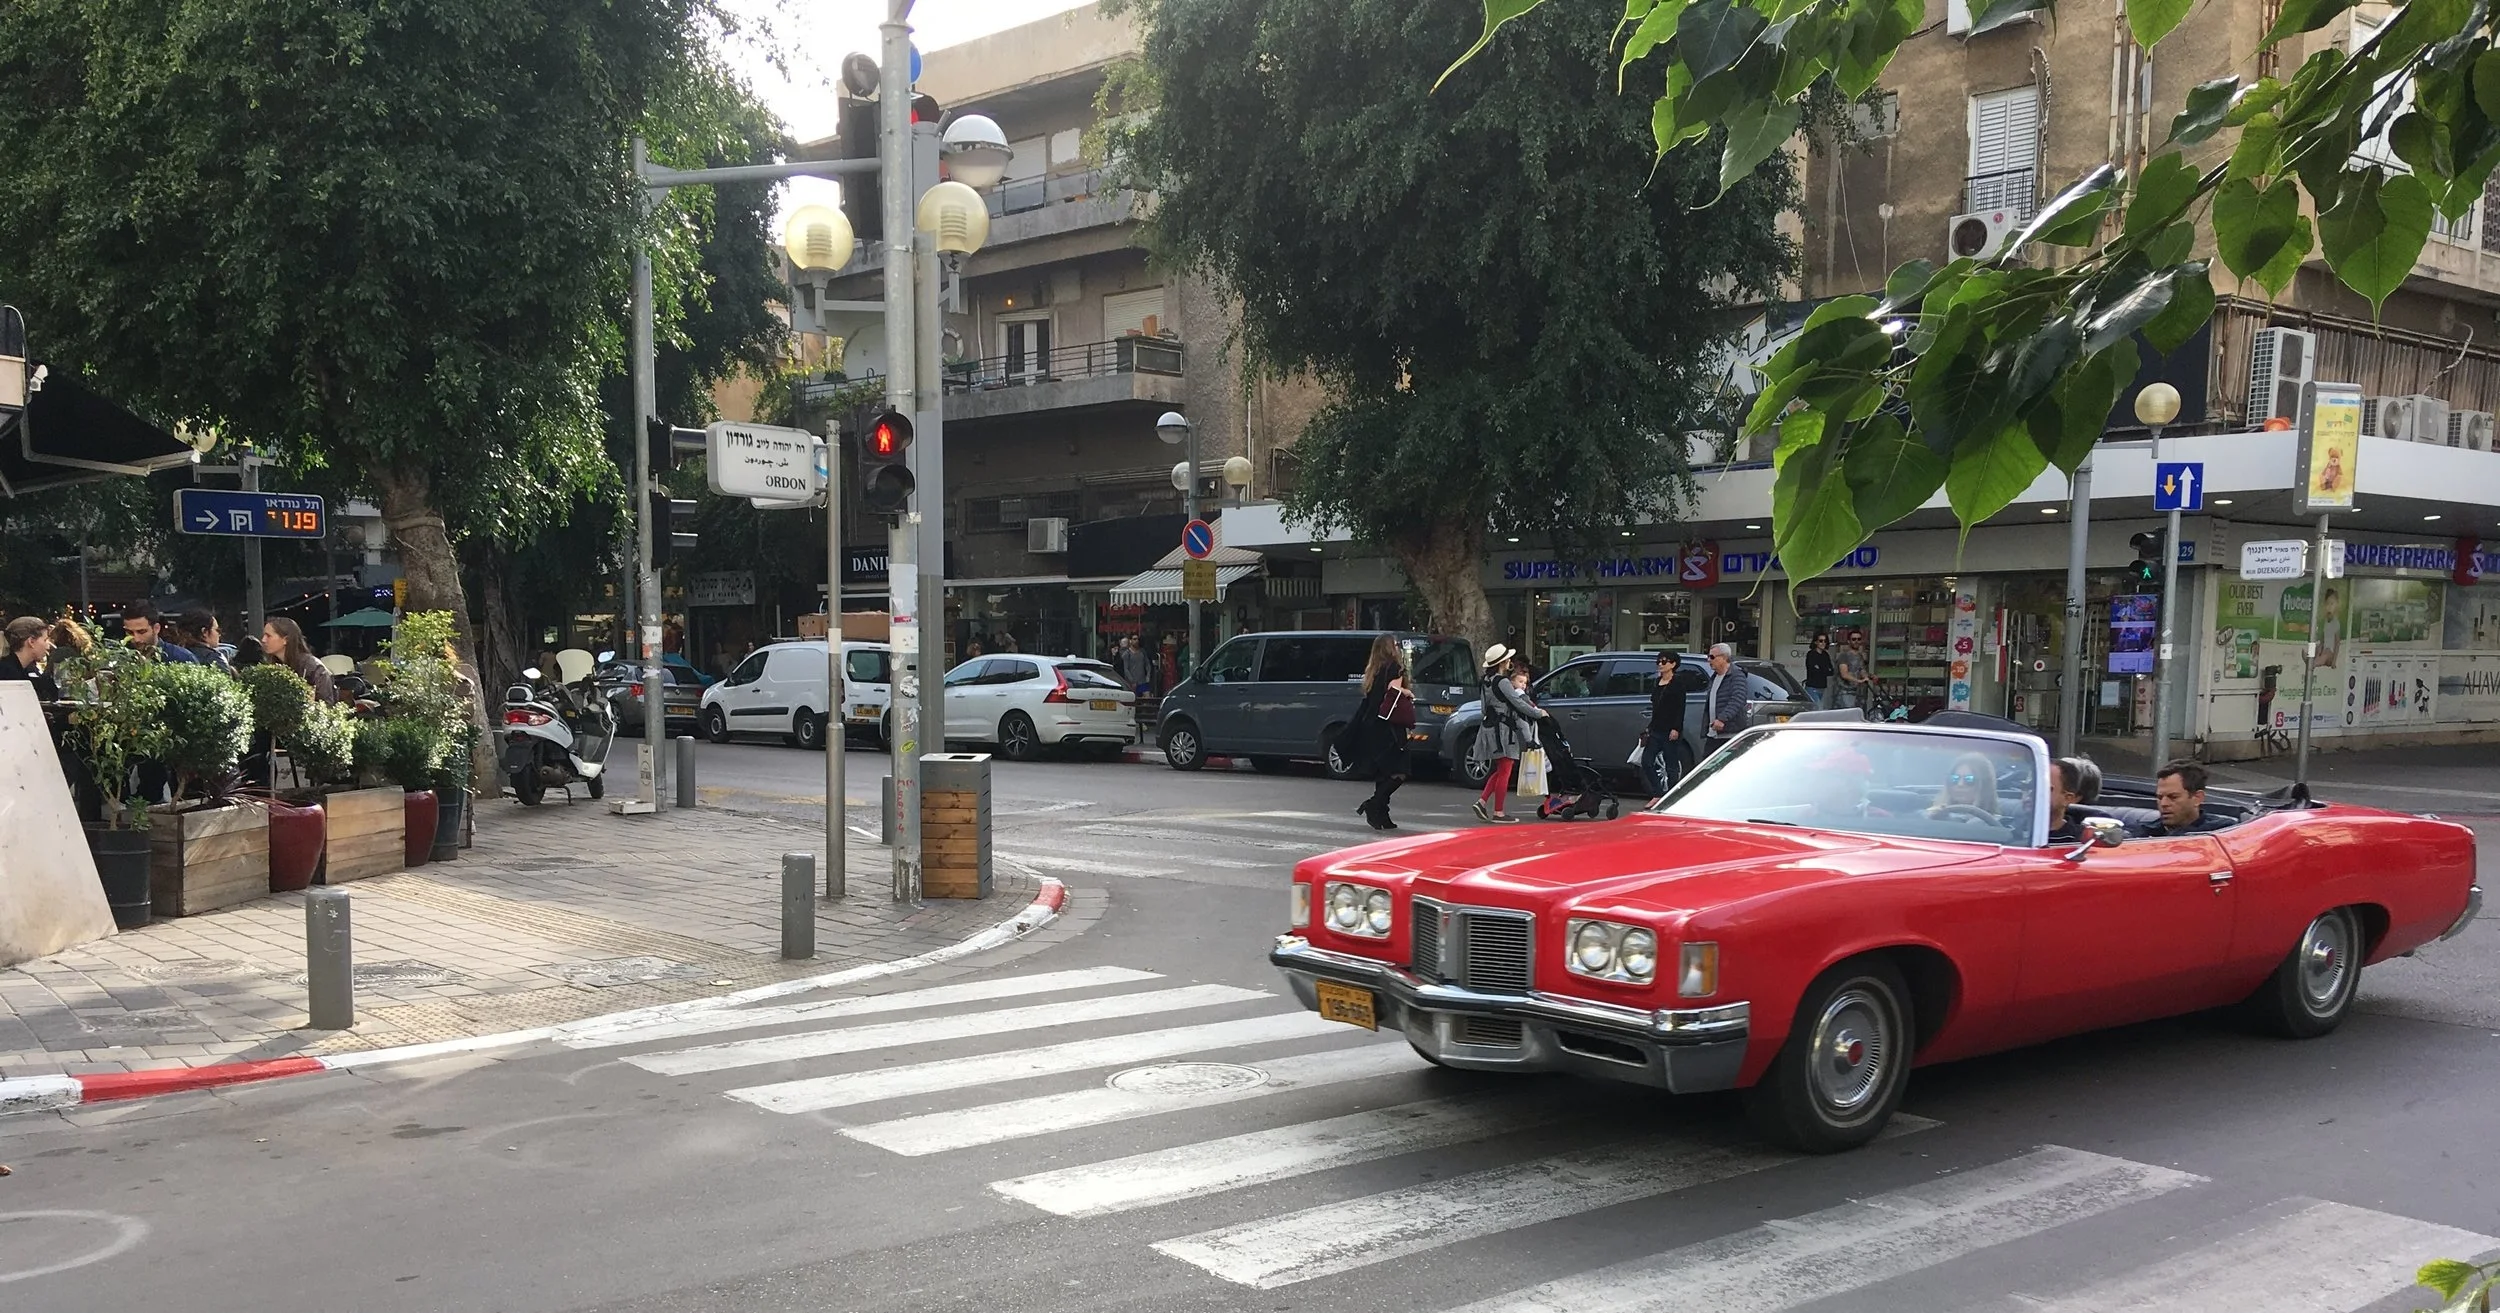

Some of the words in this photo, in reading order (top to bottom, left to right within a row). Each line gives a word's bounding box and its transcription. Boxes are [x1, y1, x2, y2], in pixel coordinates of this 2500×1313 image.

[726, 430, 754, 448] גורדון
[773, 440, 792, 452] יהודה
[765, 474, 806, 490] ORDON
[265, 499, 300, 509] נורדאו
[304, 500, 319, 510] תל
[267, 511, 317, 530] פנוי
[2179, 545, 2194, 557] 29
[2257, 566, 2290, 574] DIZENGOFF
[2229, 584, 2246, 599] OUR
[2247, 585, 2264, 600] BEST
[2236, 602, 2254, 616] EVER
